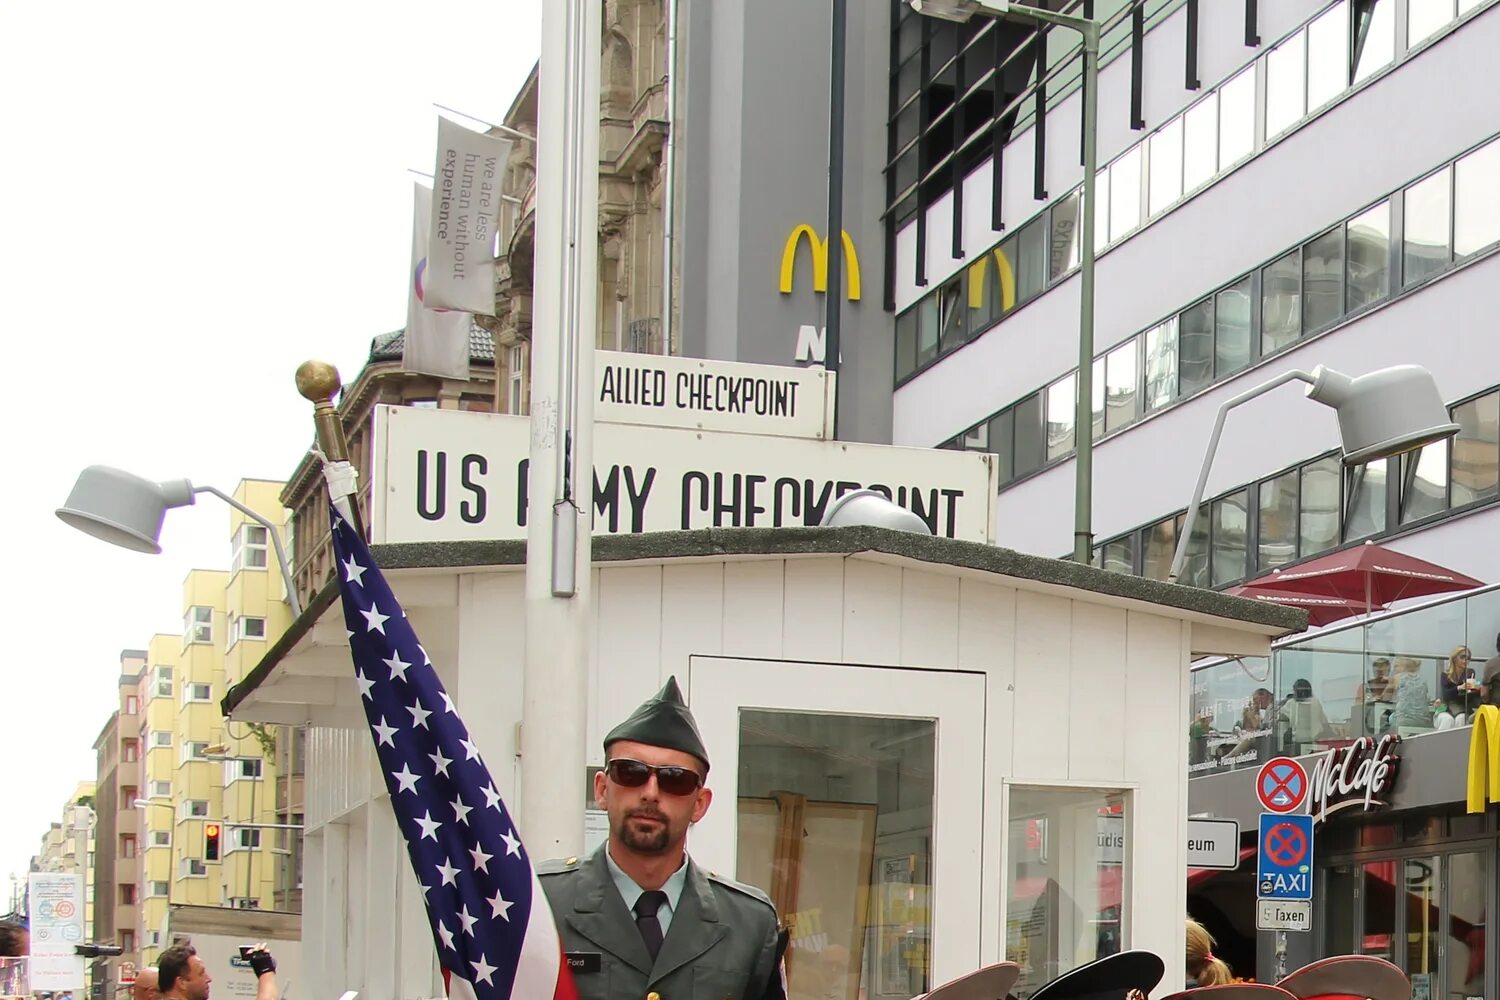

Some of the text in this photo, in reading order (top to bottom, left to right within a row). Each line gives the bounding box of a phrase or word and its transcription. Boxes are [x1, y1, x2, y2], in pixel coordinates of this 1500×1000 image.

[453, 153, 480, 281] human without
[475, 157, 497, 241] we are less
[600, 366, 800, 418] ALLIED CHECKPOINT
[416, 449, 488, 525] US
[1305, 733, 1394, 823] McCafé
[1263, 872, 1307, 892] TAXI
[1275, 907, 1305, 922] Taxen
[567, 958, 585, 967] Ford
